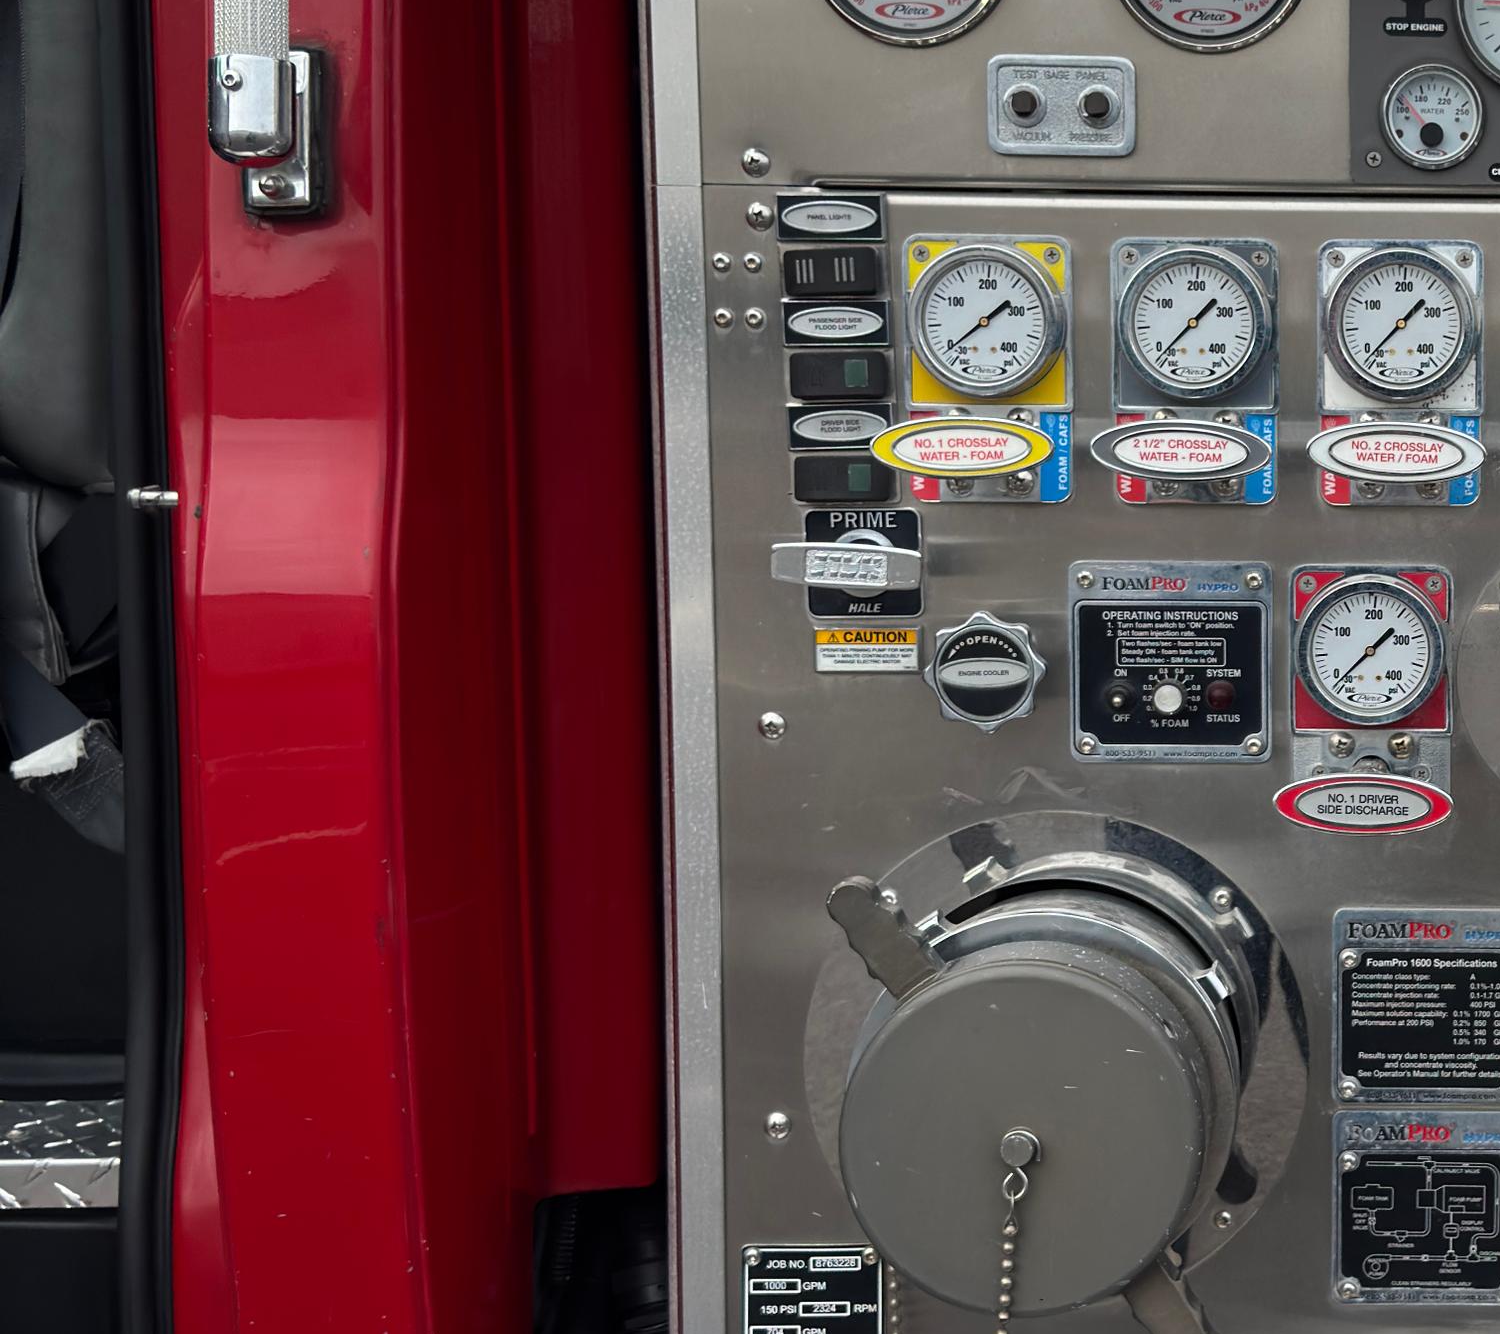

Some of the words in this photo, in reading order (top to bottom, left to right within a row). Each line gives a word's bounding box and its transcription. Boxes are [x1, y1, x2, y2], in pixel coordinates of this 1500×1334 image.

[891, 4, 929, 16] Pierce
[1189, 11, 1226, 21] Pierce
[1386, 22, 1408, 31] STOP
[1411, 23, 1444, 32] ENGINE
[979, 279, 997, 290] 200
[1008, 306, 1025, 317] 300
[1209, 343, 1226, 353] 400
[1059, 415, 1069, 439] CAFS
[914, 439, 934, 449] NO.
[948, 437, 1008, 448] CROSSLAY
[1133, 439, 1140, 448] 2
[1169, 440, 1228, 449] CROSSLAY
[1351, 440, 1372, 450] NO.
[1375, 441, 1381, 450] 2
[1384, 441, 1444, 452] CROSSLAY
[920, 450, 959, 460] WATER
[970, 450, 1004, 460] FOAM
[1140, 452, 1179, 462] WATER
[1189, 452, 1222, 462] FOAM
[1356, 453, 1396, 463] WATER
[1404, 454, 1438, 464] FOAM
[1059, 454, 1067, 490] FOAM
[830, 512, 897, 528] PRIME
[1197, 583, 1238, 592] HYPRO
[849, 603, 882, 613] HALE
[1103, 611, 1161, 620] OPERATING
[1164, 611, 1238, 620] INSTRUCTIONS
[1365, 610, 1383, 620] 200
[843, 632, 907, 643] CAUTION
[966, 636, 996, 645] OPEN
[1207, 669, 1241, 677] SYSTEM
[1207, 715, 1240, 723] STATUS
[1328, 793, 1348, 803] NO.
[1358, 794, 1398, 804] DRIVER
[1317, 805, 1342, 814] SIDE
[1345, 805, 1409, 816] DISCHARGE
[1367, 959, 1408, 967] FoamPro
[1411, 959, 1431, 967] 1600
[1434, 959, 1497, 968] Specifications
[767, 1260, 786, 1268] JOB
[789, 1260, 807, 1268] NO.
[803, 1282, 826, 1290] GPM
[761, 1306, 778, 1314] 150
[780, 1306, 797, 1314] PSI
[854, 1304, 877, 1313] RPM
